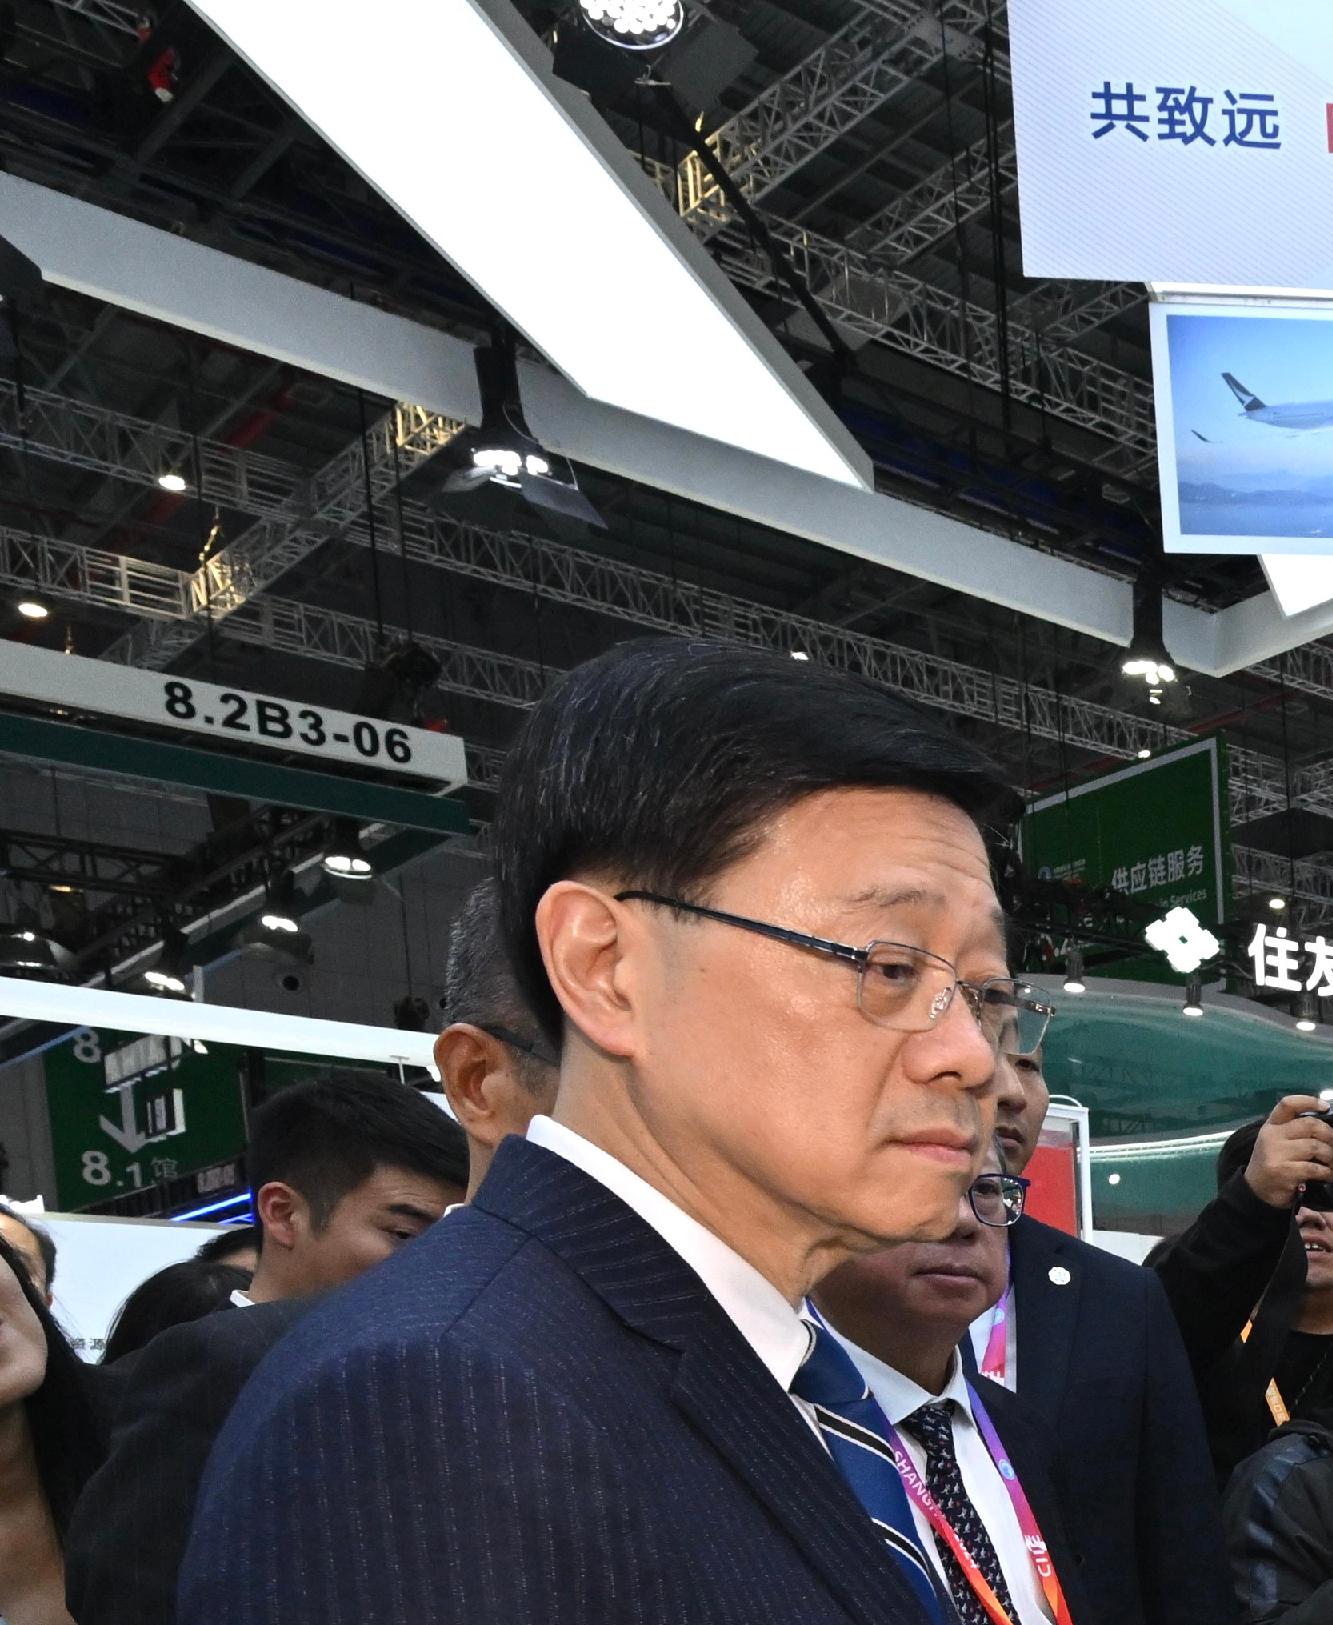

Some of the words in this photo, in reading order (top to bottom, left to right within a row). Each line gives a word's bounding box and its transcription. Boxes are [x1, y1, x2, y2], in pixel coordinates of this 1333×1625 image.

[1090, 81, 1282, 150] 共致远
[164, 681, 412, 763] 8.2B3-06
[1111, 845, 1204, 894] 供应链服务
